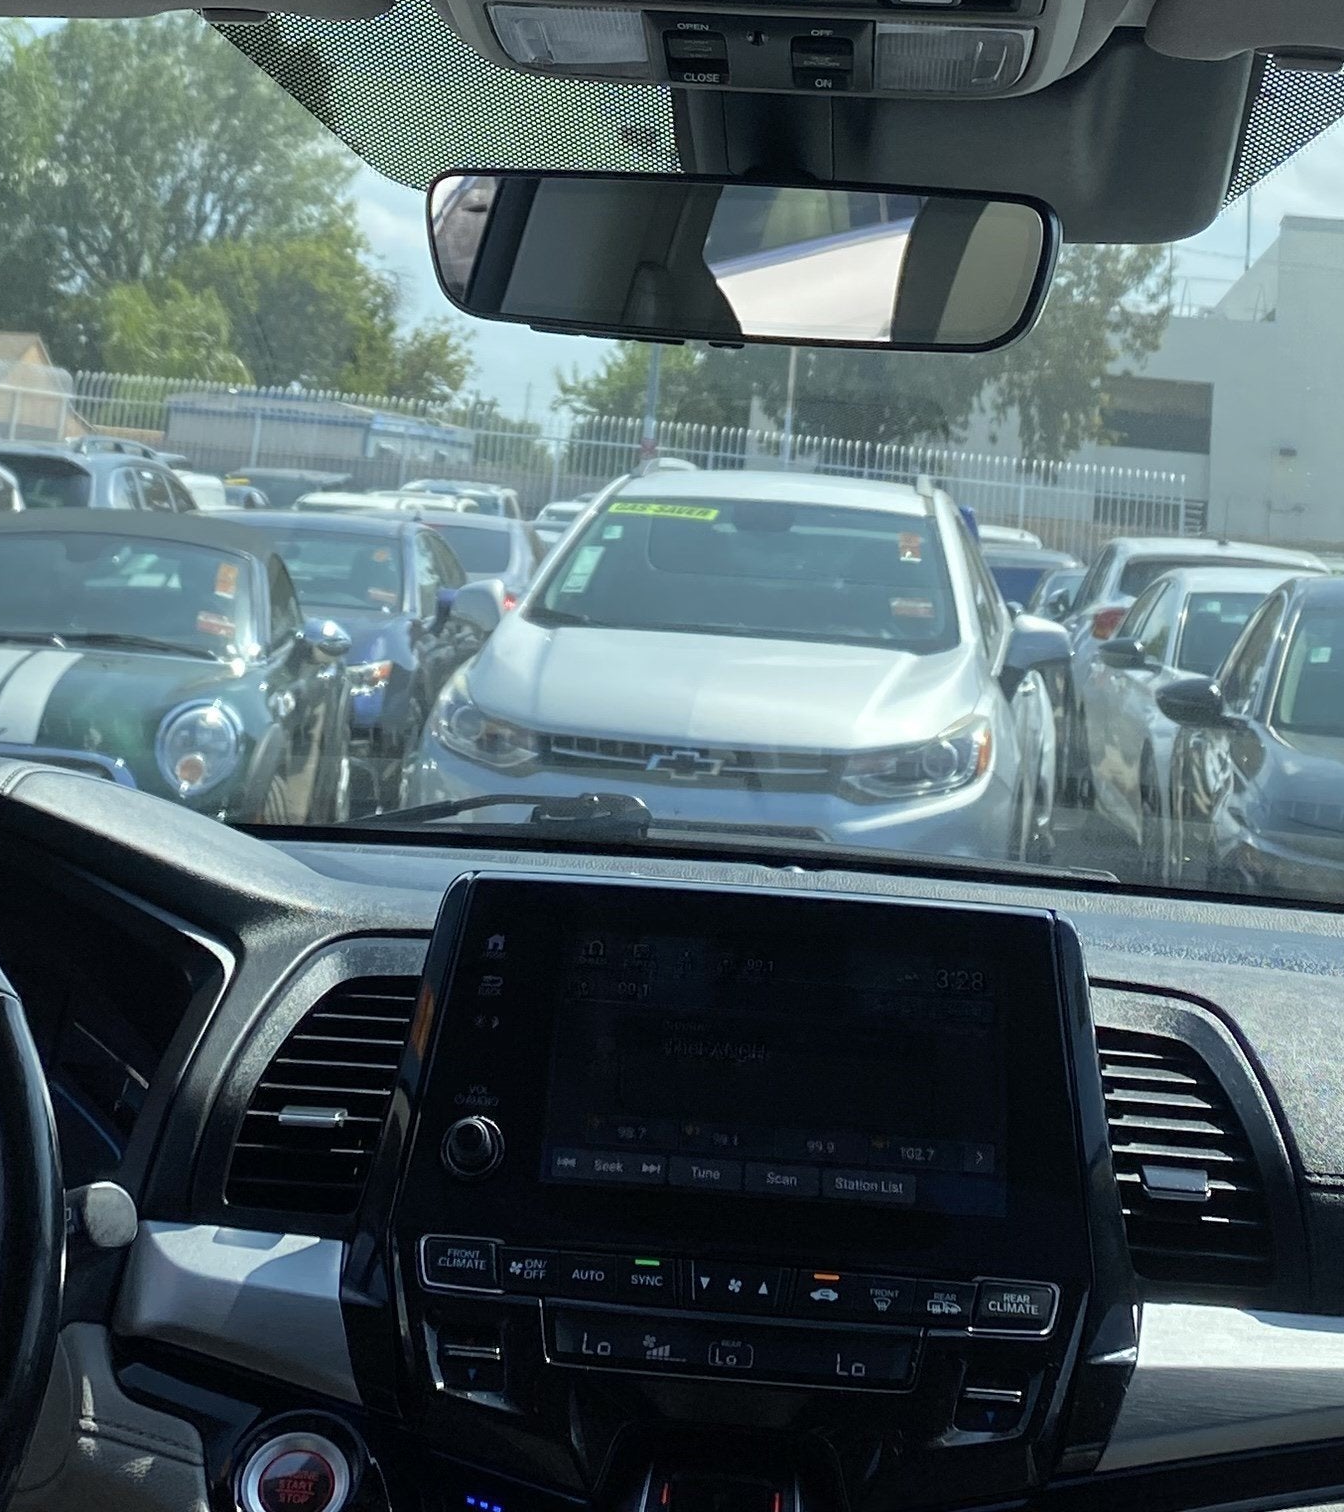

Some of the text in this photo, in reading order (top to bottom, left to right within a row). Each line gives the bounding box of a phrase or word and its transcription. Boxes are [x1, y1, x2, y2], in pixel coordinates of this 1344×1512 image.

[676, 22, 710, 31] OPEN
[810, 29, 834, 37] OFF
[683, 72, 721, 84] CLOSE
[814, 78, 833, 89] ON
[934, 969, 985, 992] 3:28
[690, 1165, 721, 1181] Tune
[765, 1171, 798, 1187] Scan
[834, 1176, 905, 1195] Station List
[446, 1248, 481, 1259] FRONT
[437, 1257, 487, 1271] CLIMATE
[522, 1269, 547, 1281] OFF
[571, 1268, 606, 1283] AUTO
[630, 1273, 665, 1288] SYNC
[868, 1286, 900, 1298] FRONT
[932, 1291, 957, 1301] REAR
[1001, 1292, 1031, 1304] REAR
[987, 1300, 1040, 1316] CLIMATE
[581, 1331, 612, 1357] Lo
[835, 1351, 866, 1377] Lo
